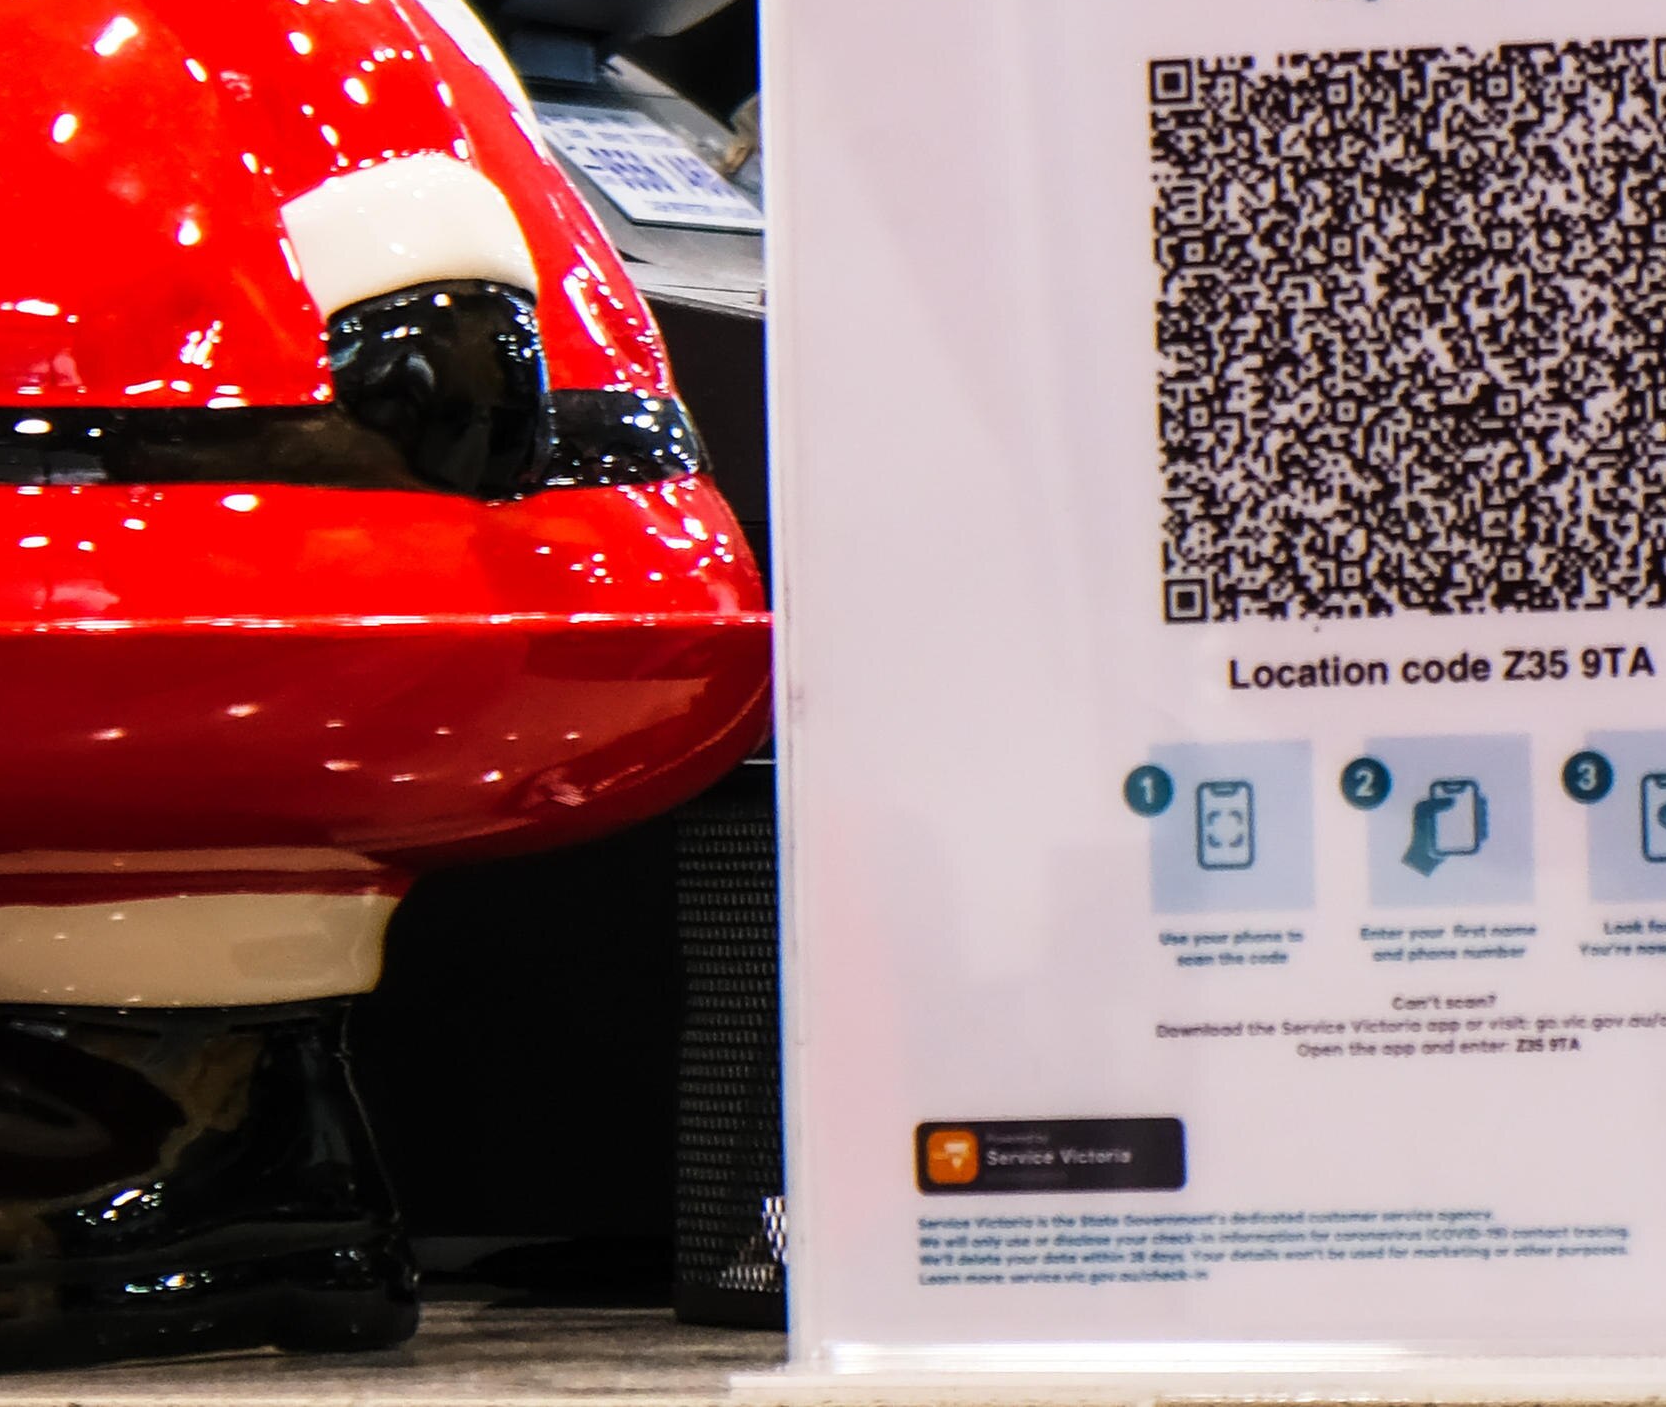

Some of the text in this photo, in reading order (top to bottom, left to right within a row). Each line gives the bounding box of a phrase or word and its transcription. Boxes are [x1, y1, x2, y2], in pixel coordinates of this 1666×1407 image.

[1227, 646, 1656, 691] Location code Z35 9TA
[1354, 771, 1376, 798] 2
[1576, 763, 1598, 790] 3
[1139, 778, 1157, 804] 1
[1360, 924, 1537, 943] Enter your first name
[1604, 919, 1642, 935] Look
[1159, 930, 1305, 947] Use your phone to
[1177, 951, 1288, 966] scan the code
[1373, 945, 1526, 962] and phone number
[1155, 1022, 1244, 1039] Download
[1247, 1022, 1276, 1036] the
[1282, 1021, 1346, 1036] Service
[1351, 1019, 1422, 1034] Victoria
[1427, 1020, 1461, 1034] app
[1465, 1020, 1483, 1031] or
[1296, 1042, 1343, 1058] Open
[1348, 1042, 1376, 1056] the
[1383, 1044, 1416, 1059] app
[1421, 1041, 1455, 1056] and
[1516, 1037, 1545, 1054] Z35
[1548, 1036, 1582, 1052] 9TA
[985, 1146, 1132, 1167] Service Victoria
